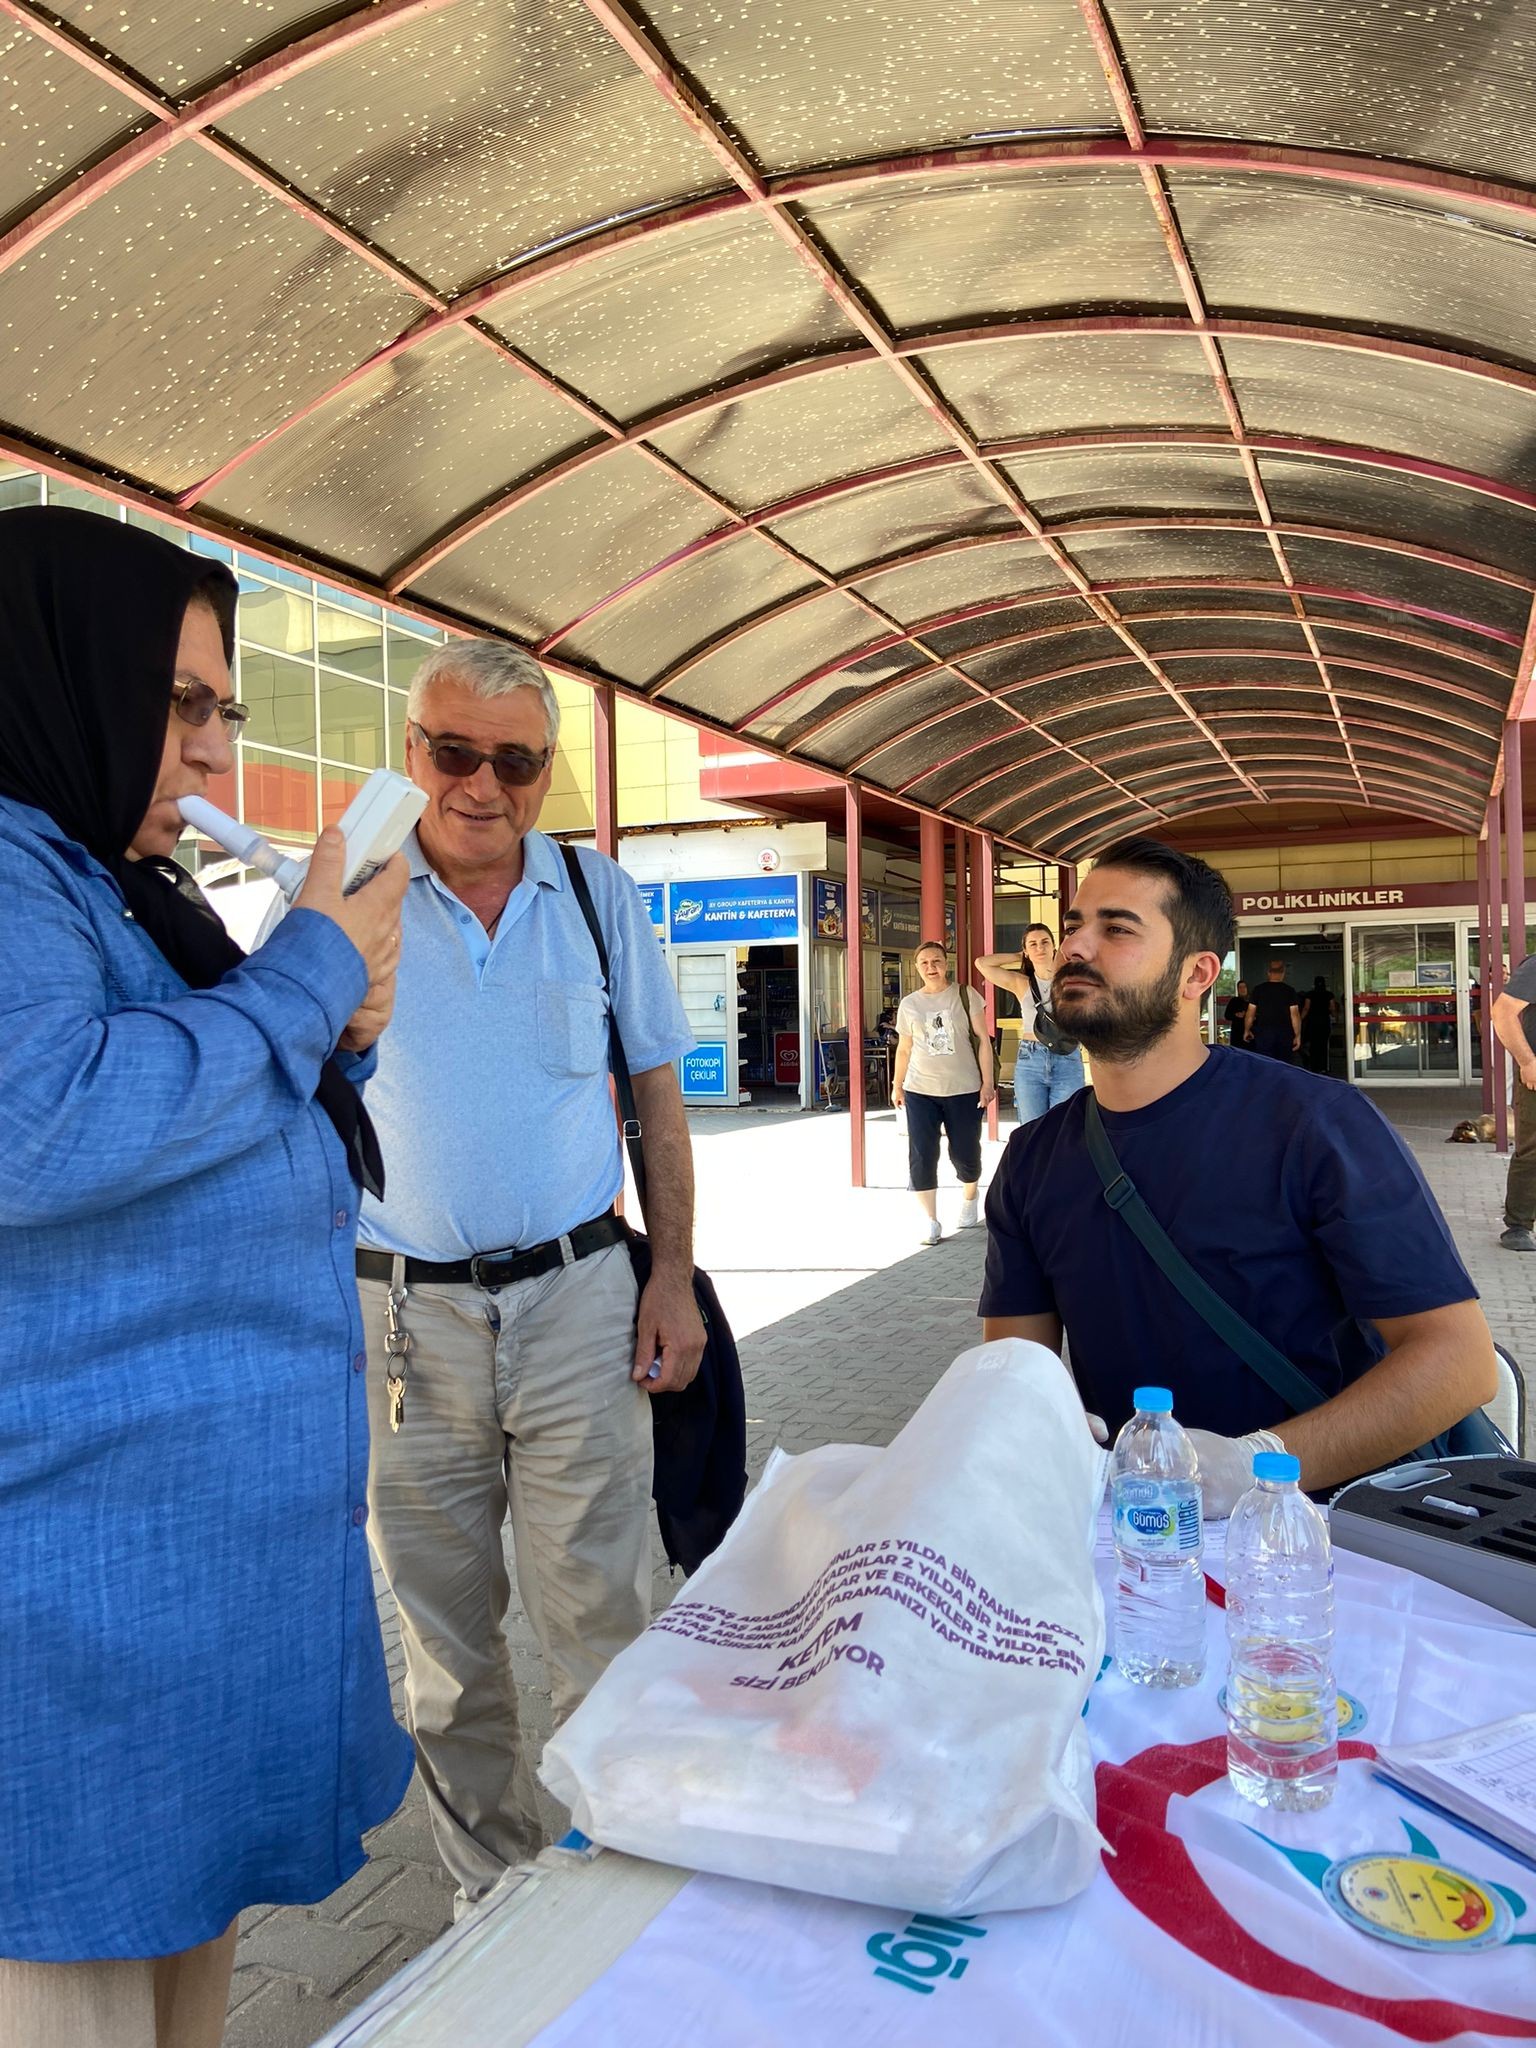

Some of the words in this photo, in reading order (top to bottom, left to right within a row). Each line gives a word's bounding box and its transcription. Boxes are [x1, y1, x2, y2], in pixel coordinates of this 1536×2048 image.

[704, 909, 737, 921] KANTİN
[739, 910, 746, 919] &
[747, 908, 797, 919] KAFETERYA
[1242, 889, 1404, 911] POLİKLİNİKLER
[708, 1604, 738, 1620] YAŞ
[879, 1540, 891, 1551] 5
[896, 1539, 947, 1571] YILDA
[951, 1563, 977, 1593] BİR
[978, 1586, 1031, 1627] RAHİM
[719, 1619, 750, 1633] YAŞ
[822, 1554, 899, 1590] KADINLAR
[901, 1556, 914, 1570] 2
[918, 1561, 963, 1607] YILDA
[965, 1598, 992, 1629] BİR
[996, 1621, 1058, 1646] MEME,
[681, 1618, 711, 1633] YAŞ
[865, 1569, 889, 1580] VE
[892, 1570, 974, 1636] ERKEKLER
[976, 1628, 988, 1643] 2
[992, 1634, 1051, 1656] YILDA
[1056, 1648, 1086, 1672] BİR
[694, 1634, 775, 1649] BAĞIRSAK
[826, 1585, 927, 1620] TARAMANIZI
[930, 1612, 1033, 1667] YAPTIRMAK
[1039, 1656, 1079, 1676] İÇİN
[778, 1612, 863, 1671] KETEM
[779, 1645, 885, 1690] BEKLİYOR
